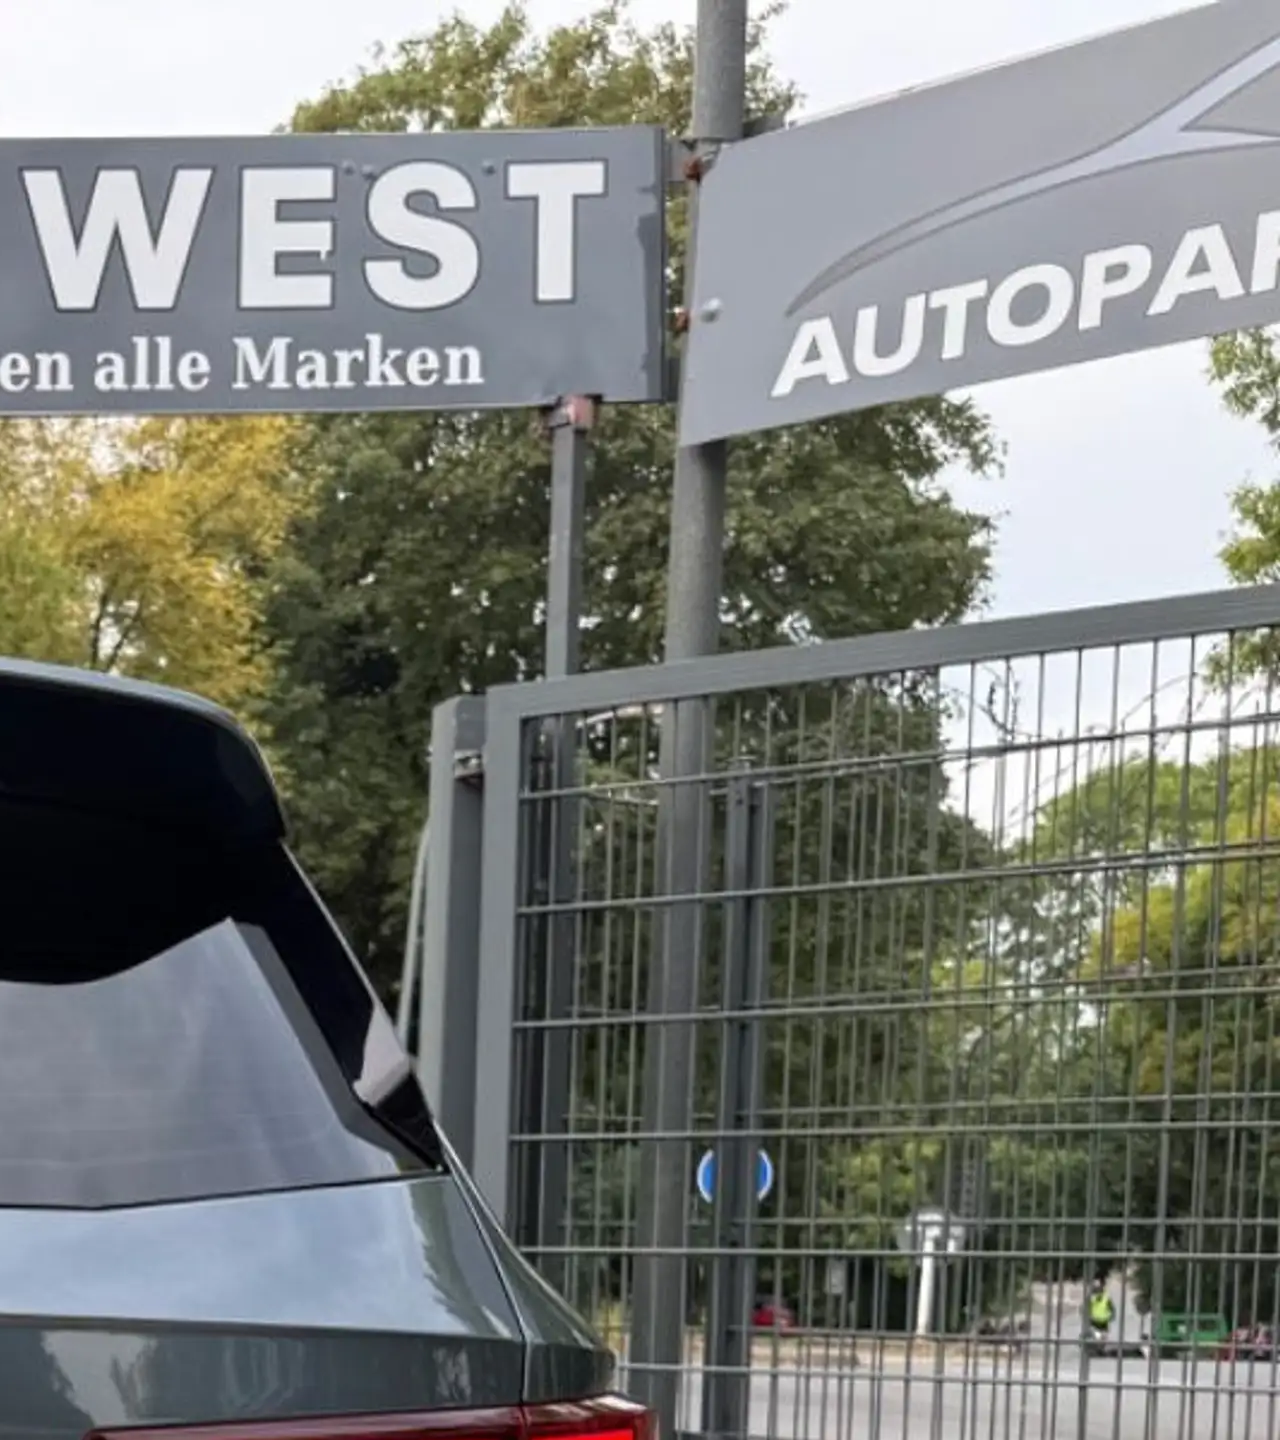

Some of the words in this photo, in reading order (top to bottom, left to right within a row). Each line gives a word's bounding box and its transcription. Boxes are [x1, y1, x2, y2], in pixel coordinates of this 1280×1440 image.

[22, 160, 606, 310] WEST
[93, 335, 212, 391] alle
[230, 332, 485, 390] Marken
